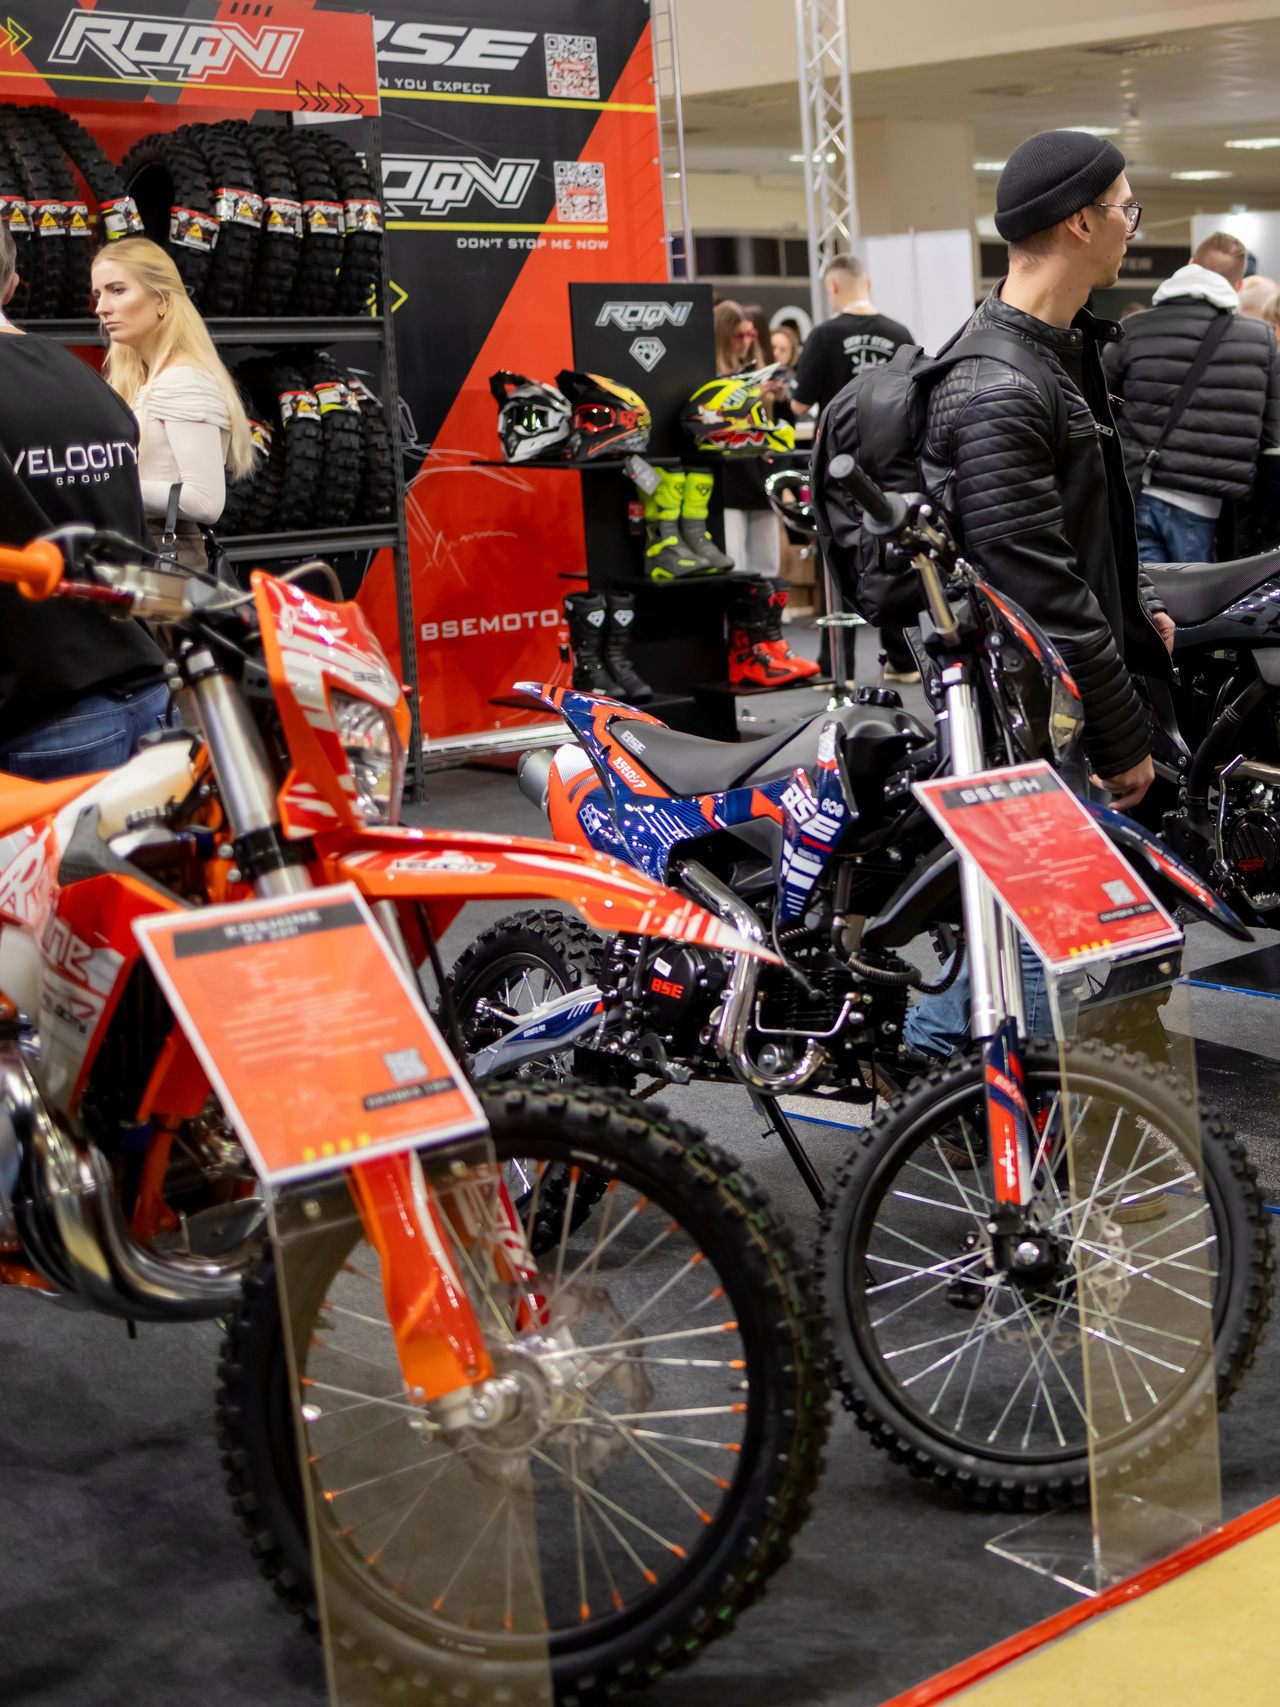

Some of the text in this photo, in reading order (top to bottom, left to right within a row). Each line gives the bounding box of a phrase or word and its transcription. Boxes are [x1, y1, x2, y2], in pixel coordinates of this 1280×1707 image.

[51, 11, 302, 80] ROQNI
[394, 78, 427, 91] YOU
[433, 80, 491, 94] EXPECT
[381, 155, 538, 213] OQNI
[457, 237, 609, 250] DON'T STOP ME NOW
[595, 302, 693, 331] ROQNI
[56, 472, 110, 486] GROUP
[621, 730, 647, 755] BSE
[960, 778, 1041, 804] BSE PH
[650, 977, 685, 999] BSE
